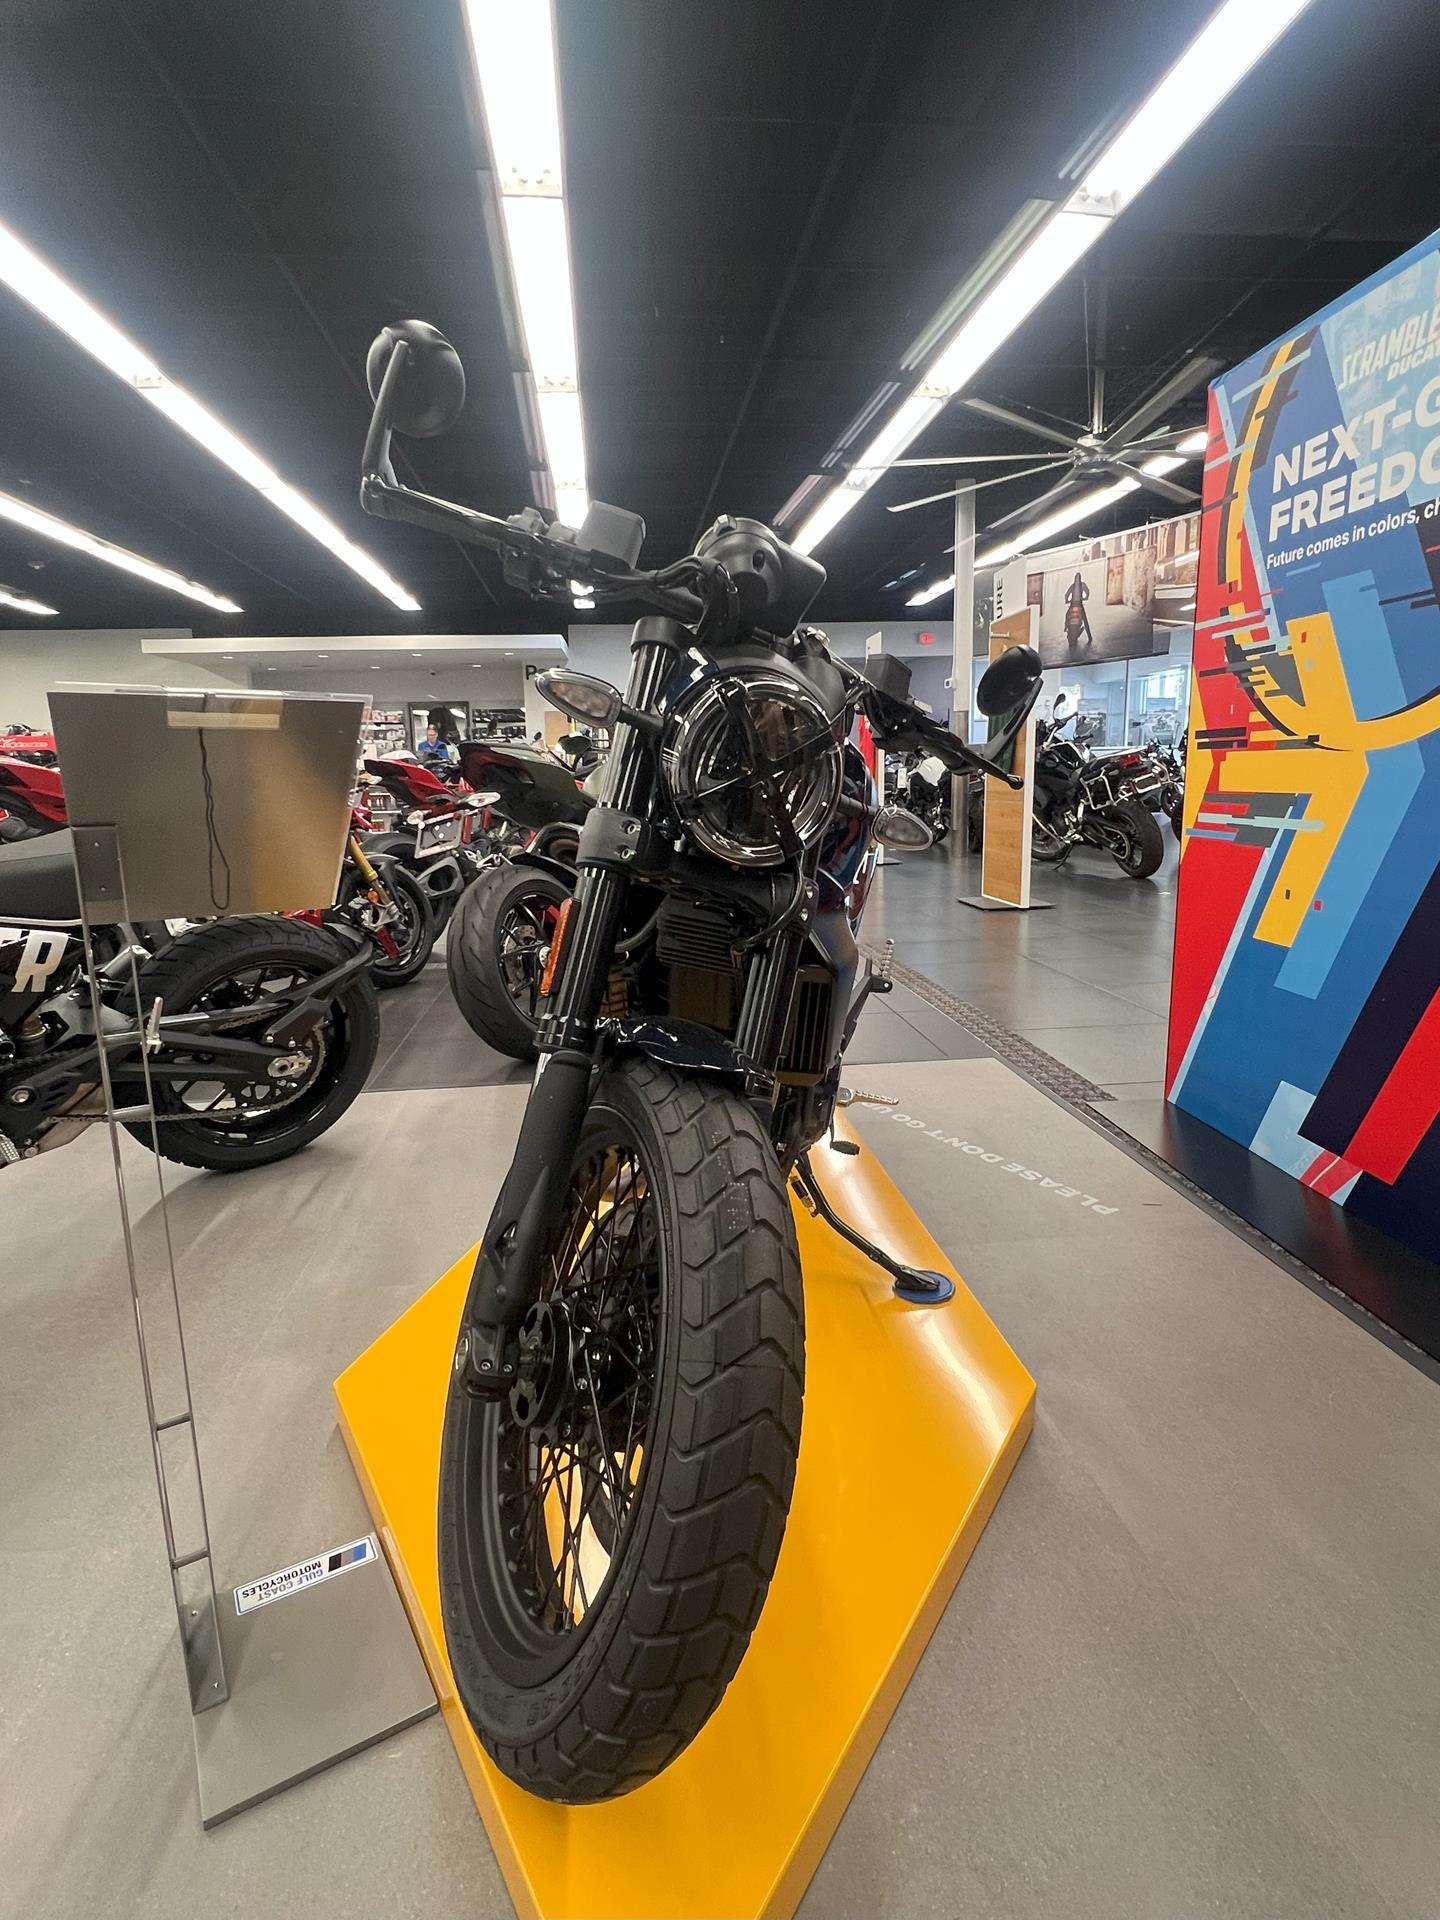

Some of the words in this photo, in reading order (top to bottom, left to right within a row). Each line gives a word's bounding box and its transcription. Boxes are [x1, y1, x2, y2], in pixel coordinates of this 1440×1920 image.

[1266, 547, 1304, 570] Future
[1306, 531, 1350, 557] comes
[1352, 525, 1366, 543] in
[1368, 510, 1420, 537] colors,
[891, 1113, 926, 1128] GO
[1002, 1161, 1119, 1215] PLEASE
[242, 1560, 322, 1599] MOTORCYCLES
[298, 1568, 324, 1585] GULF
[257, 1582, 294, 1602] COAST
